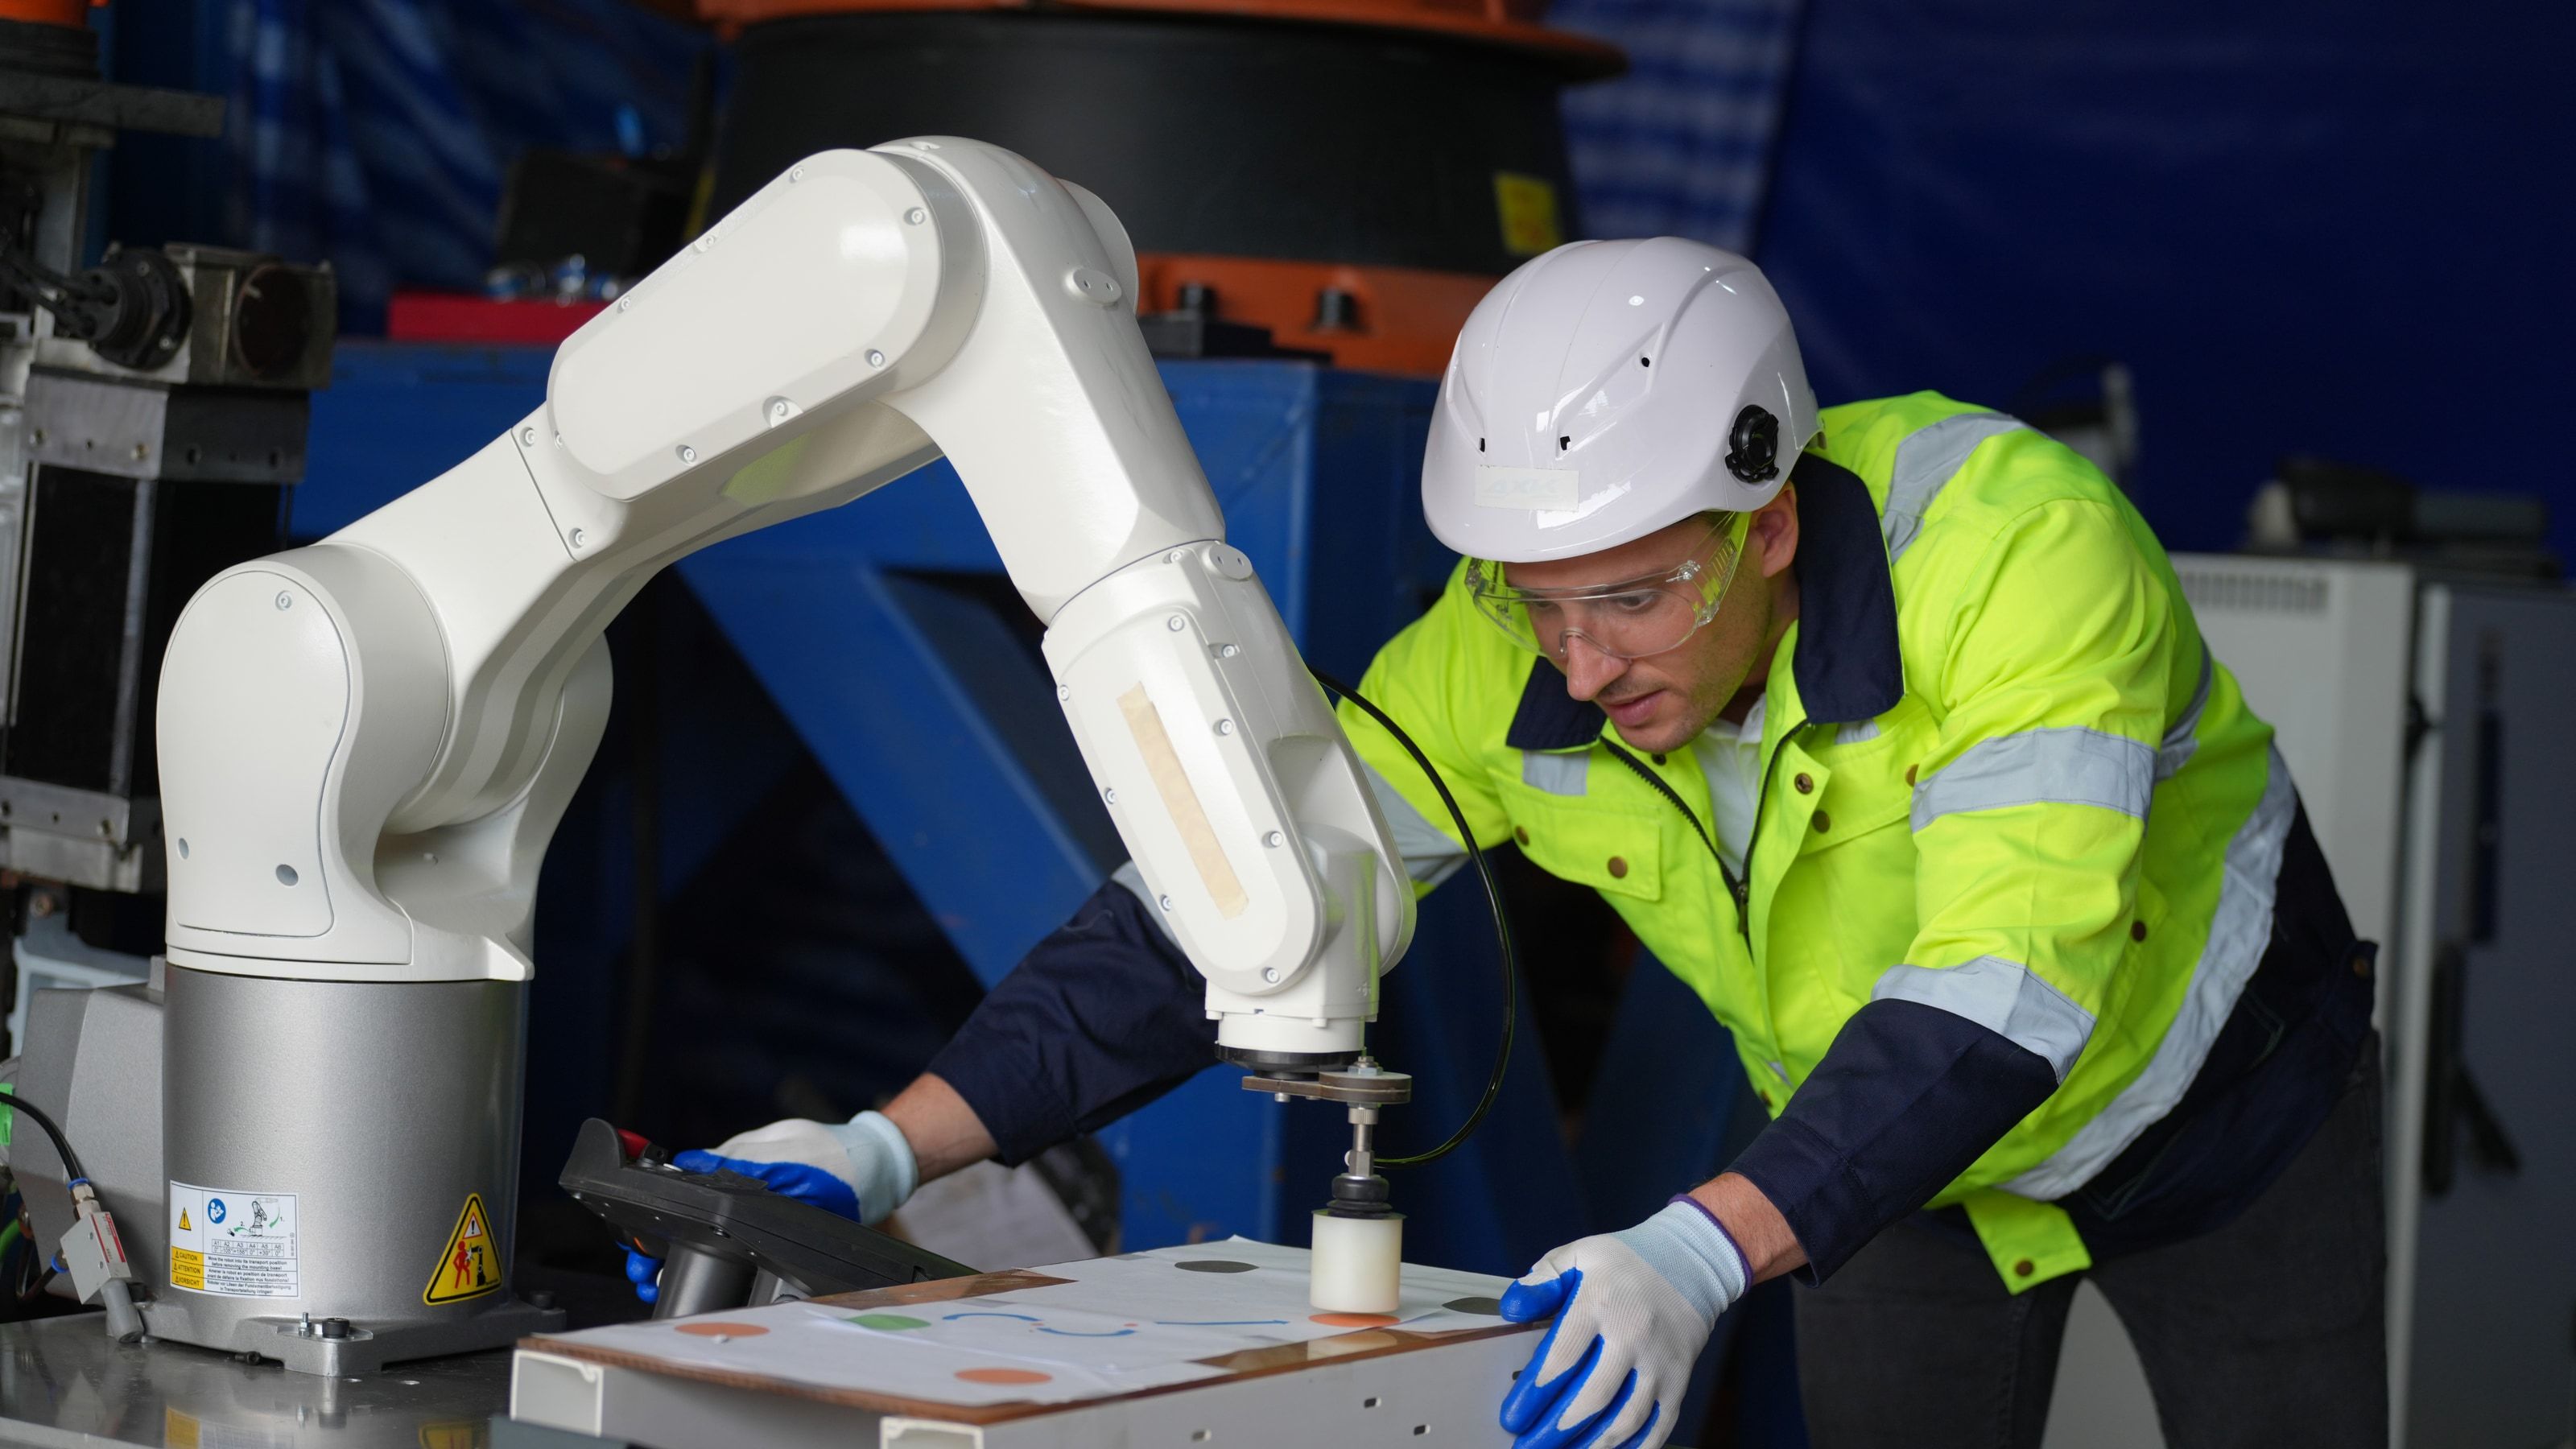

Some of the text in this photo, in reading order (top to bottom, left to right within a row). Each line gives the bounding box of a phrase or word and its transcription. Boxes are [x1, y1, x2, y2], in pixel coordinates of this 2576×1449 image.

[180, 1252, 198, 1261] CAUTION
[179, 1264, 200, 1274] ATTENTION
[179, 1277, 200, 1286] VORSICHT
